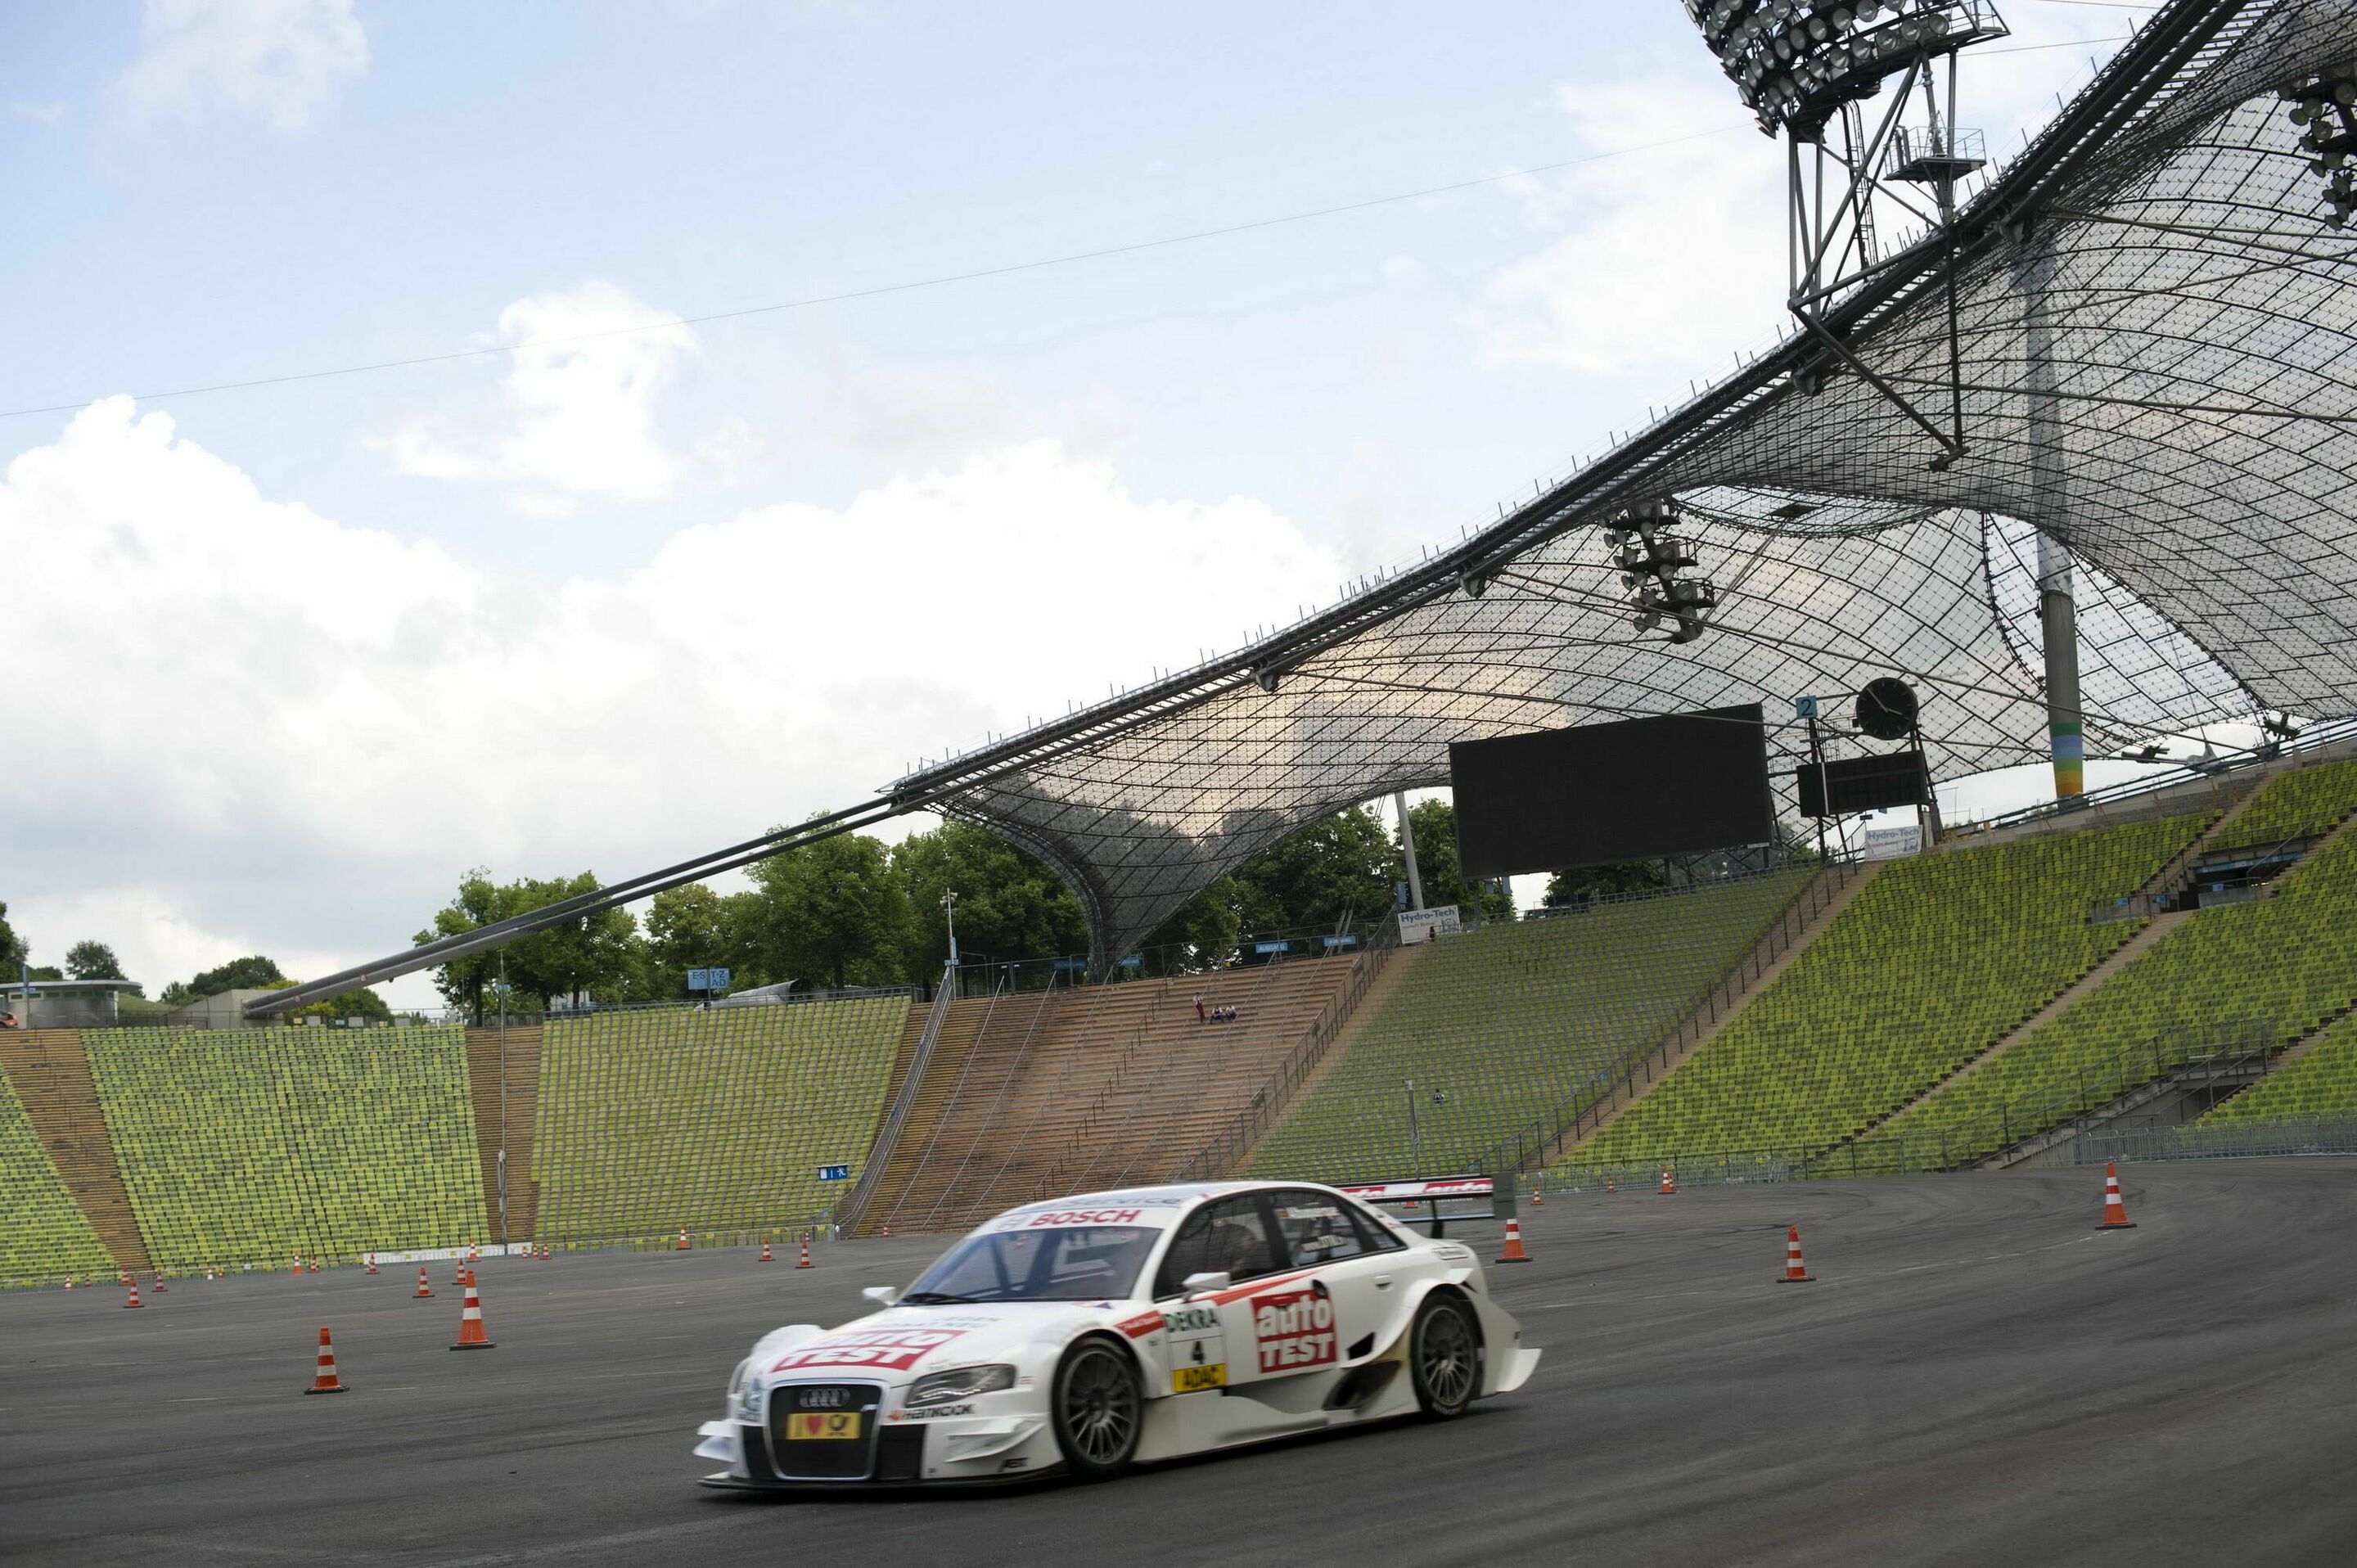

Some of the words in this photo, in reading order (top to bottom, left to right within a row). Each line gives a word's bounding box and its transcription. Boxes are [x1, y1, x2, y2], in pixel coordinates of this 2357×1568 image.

[1800, 699, 1814, 716] 2
[1868, 828, 1919, 841] Hydro-Tech
[1400, 908, 1455, 923] Hydro-Tech
[711, 970, 725, 979] T-Z
[1028, 1210, 1142, 1227] BOSCH
[1165, 1308, 1220, 1334] DEKRA
[1258, 1294, 1332, 1338] auto
[778, 1347, 930, 1365] TEST
[1192, 1340, 1206, 1365] 4
[1259, 1332, 1334, 1367] TEST
[1183, 1366, 1222, 1387] ADAC
